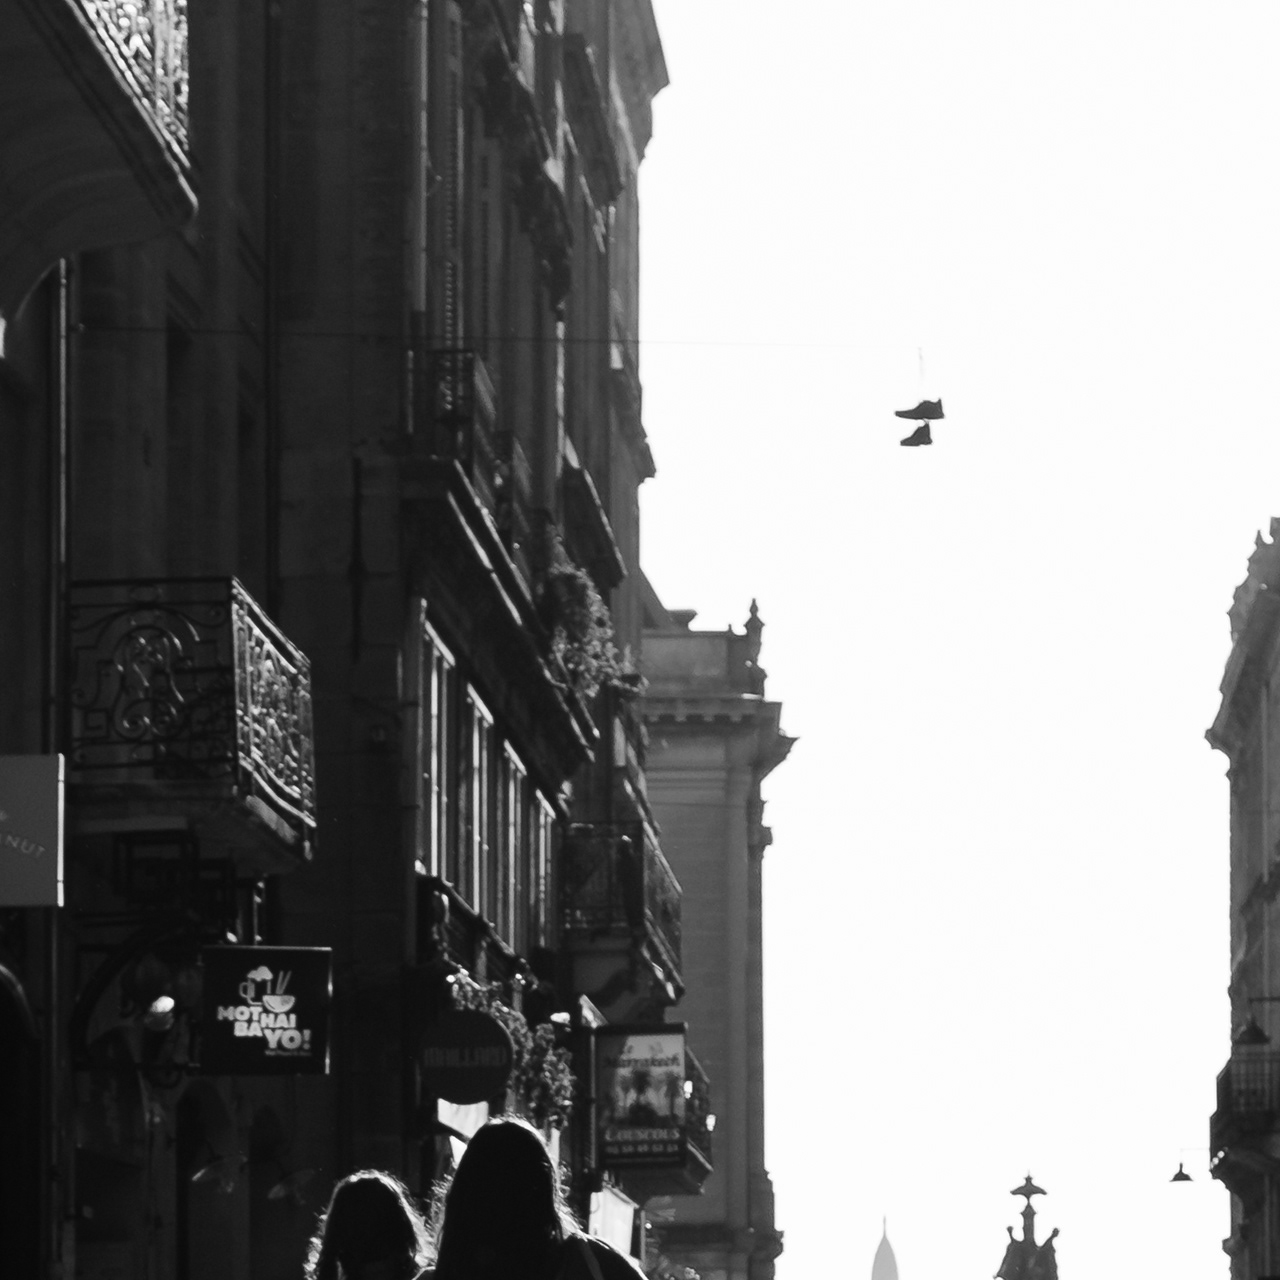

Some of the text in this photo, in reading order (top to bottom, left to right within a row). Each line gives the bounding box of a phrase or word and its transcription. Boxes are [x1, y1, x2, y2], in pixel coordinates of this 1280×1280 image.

[216, 1005, 263, 1021] MOT
[233, 1021, 312, 1050] BA YO!
